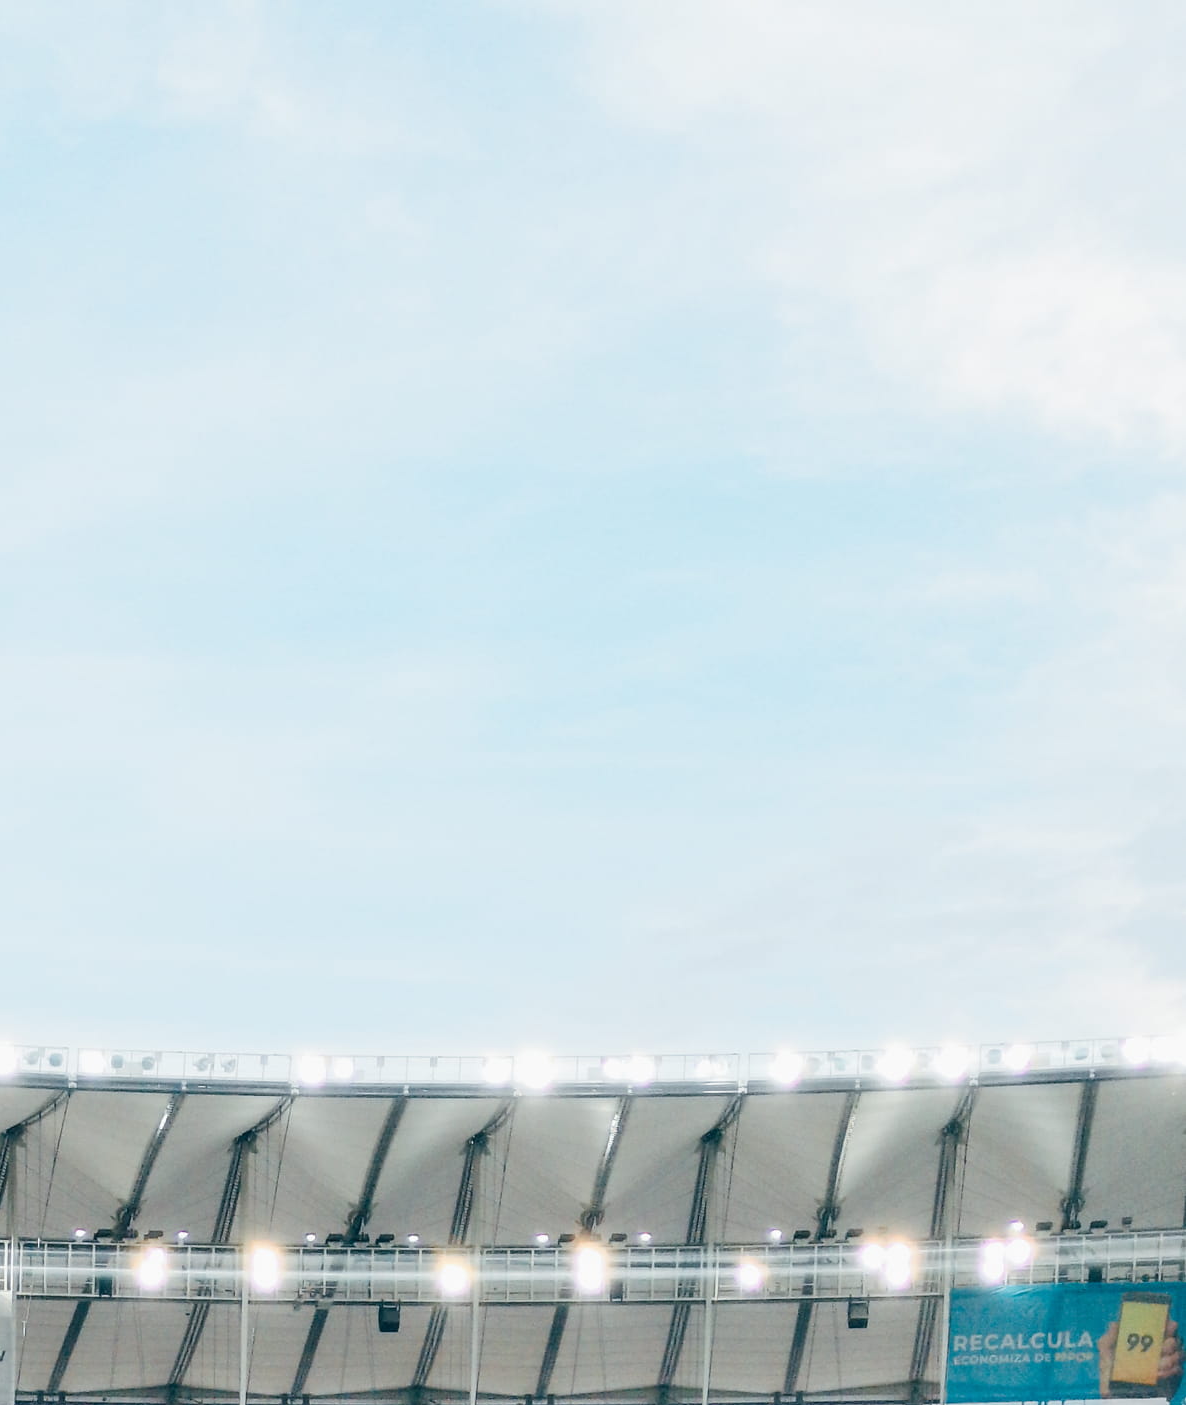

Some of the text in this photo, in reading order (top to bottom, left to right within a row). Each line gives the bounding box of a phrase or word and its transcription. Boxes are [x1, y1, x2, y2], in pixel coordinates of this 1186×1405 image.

[953, 1331, 1093, 1352] RECALCULA
[1127, 1333, 1154, 1352] 99
[954, 1354, 1031, 1365] ECONOMIZA
[1034, 1353, 1051, 1363] DE
